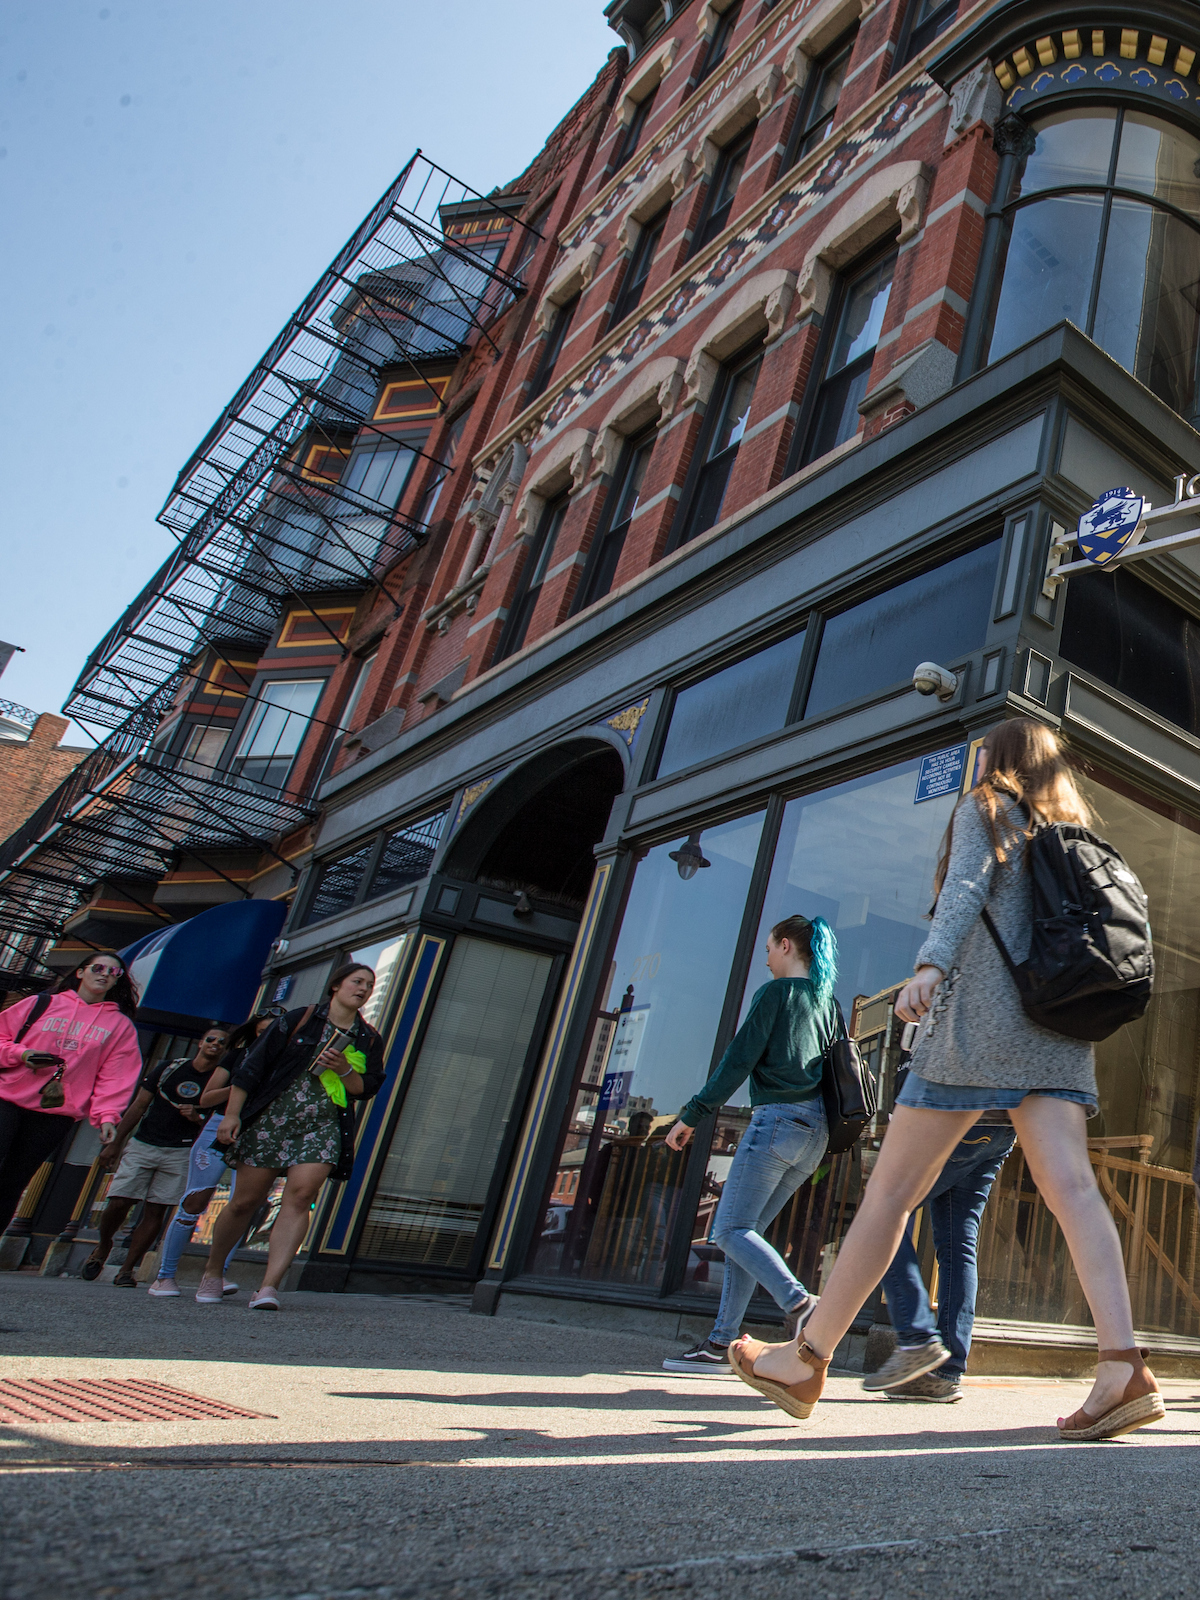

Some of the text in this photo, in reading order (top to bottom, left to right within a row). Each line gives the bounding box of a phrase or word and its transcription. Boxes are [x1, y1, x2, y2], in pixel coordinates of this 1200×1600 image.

[659, 0, 811, 156] RICHMOND BU
[1104, 488, 1121, 499] 1914
[922, 764, 961, 781] RECORDING ACTIVITIES
[925, 760, 960, 775] SECURITY CAMERAS
[629, 952, 662, 983] 270
[604, 1078, 624, 1095] 270
